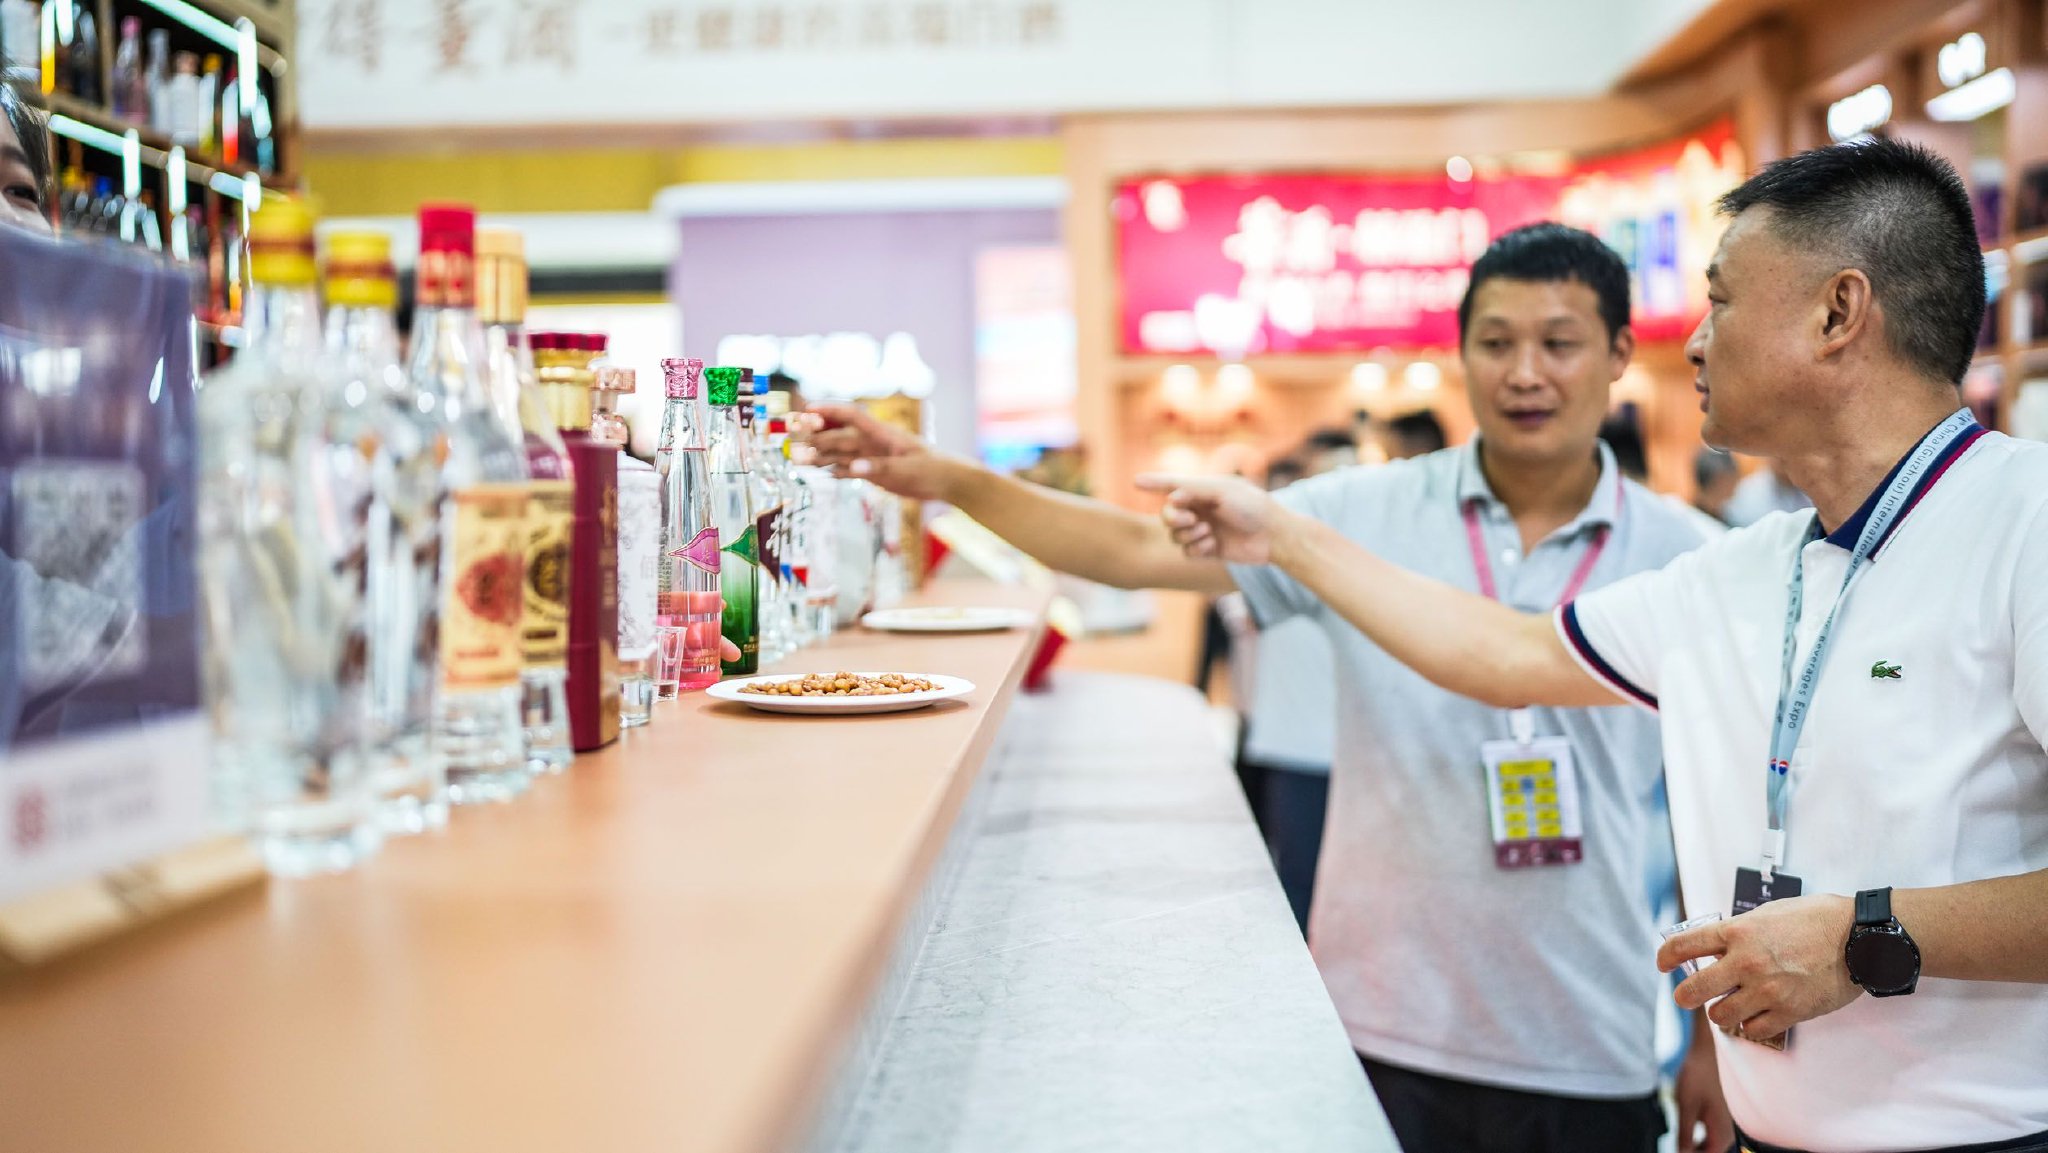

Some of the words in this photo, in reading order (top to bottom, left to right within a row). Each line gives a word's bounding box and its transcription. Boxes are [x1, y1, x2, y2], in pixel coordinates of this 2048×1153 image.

[1852, 495, 1900, 569] International
[1799, 635, 1826, 696] Beverages
[1788, 701, 1805, 729] Expo
